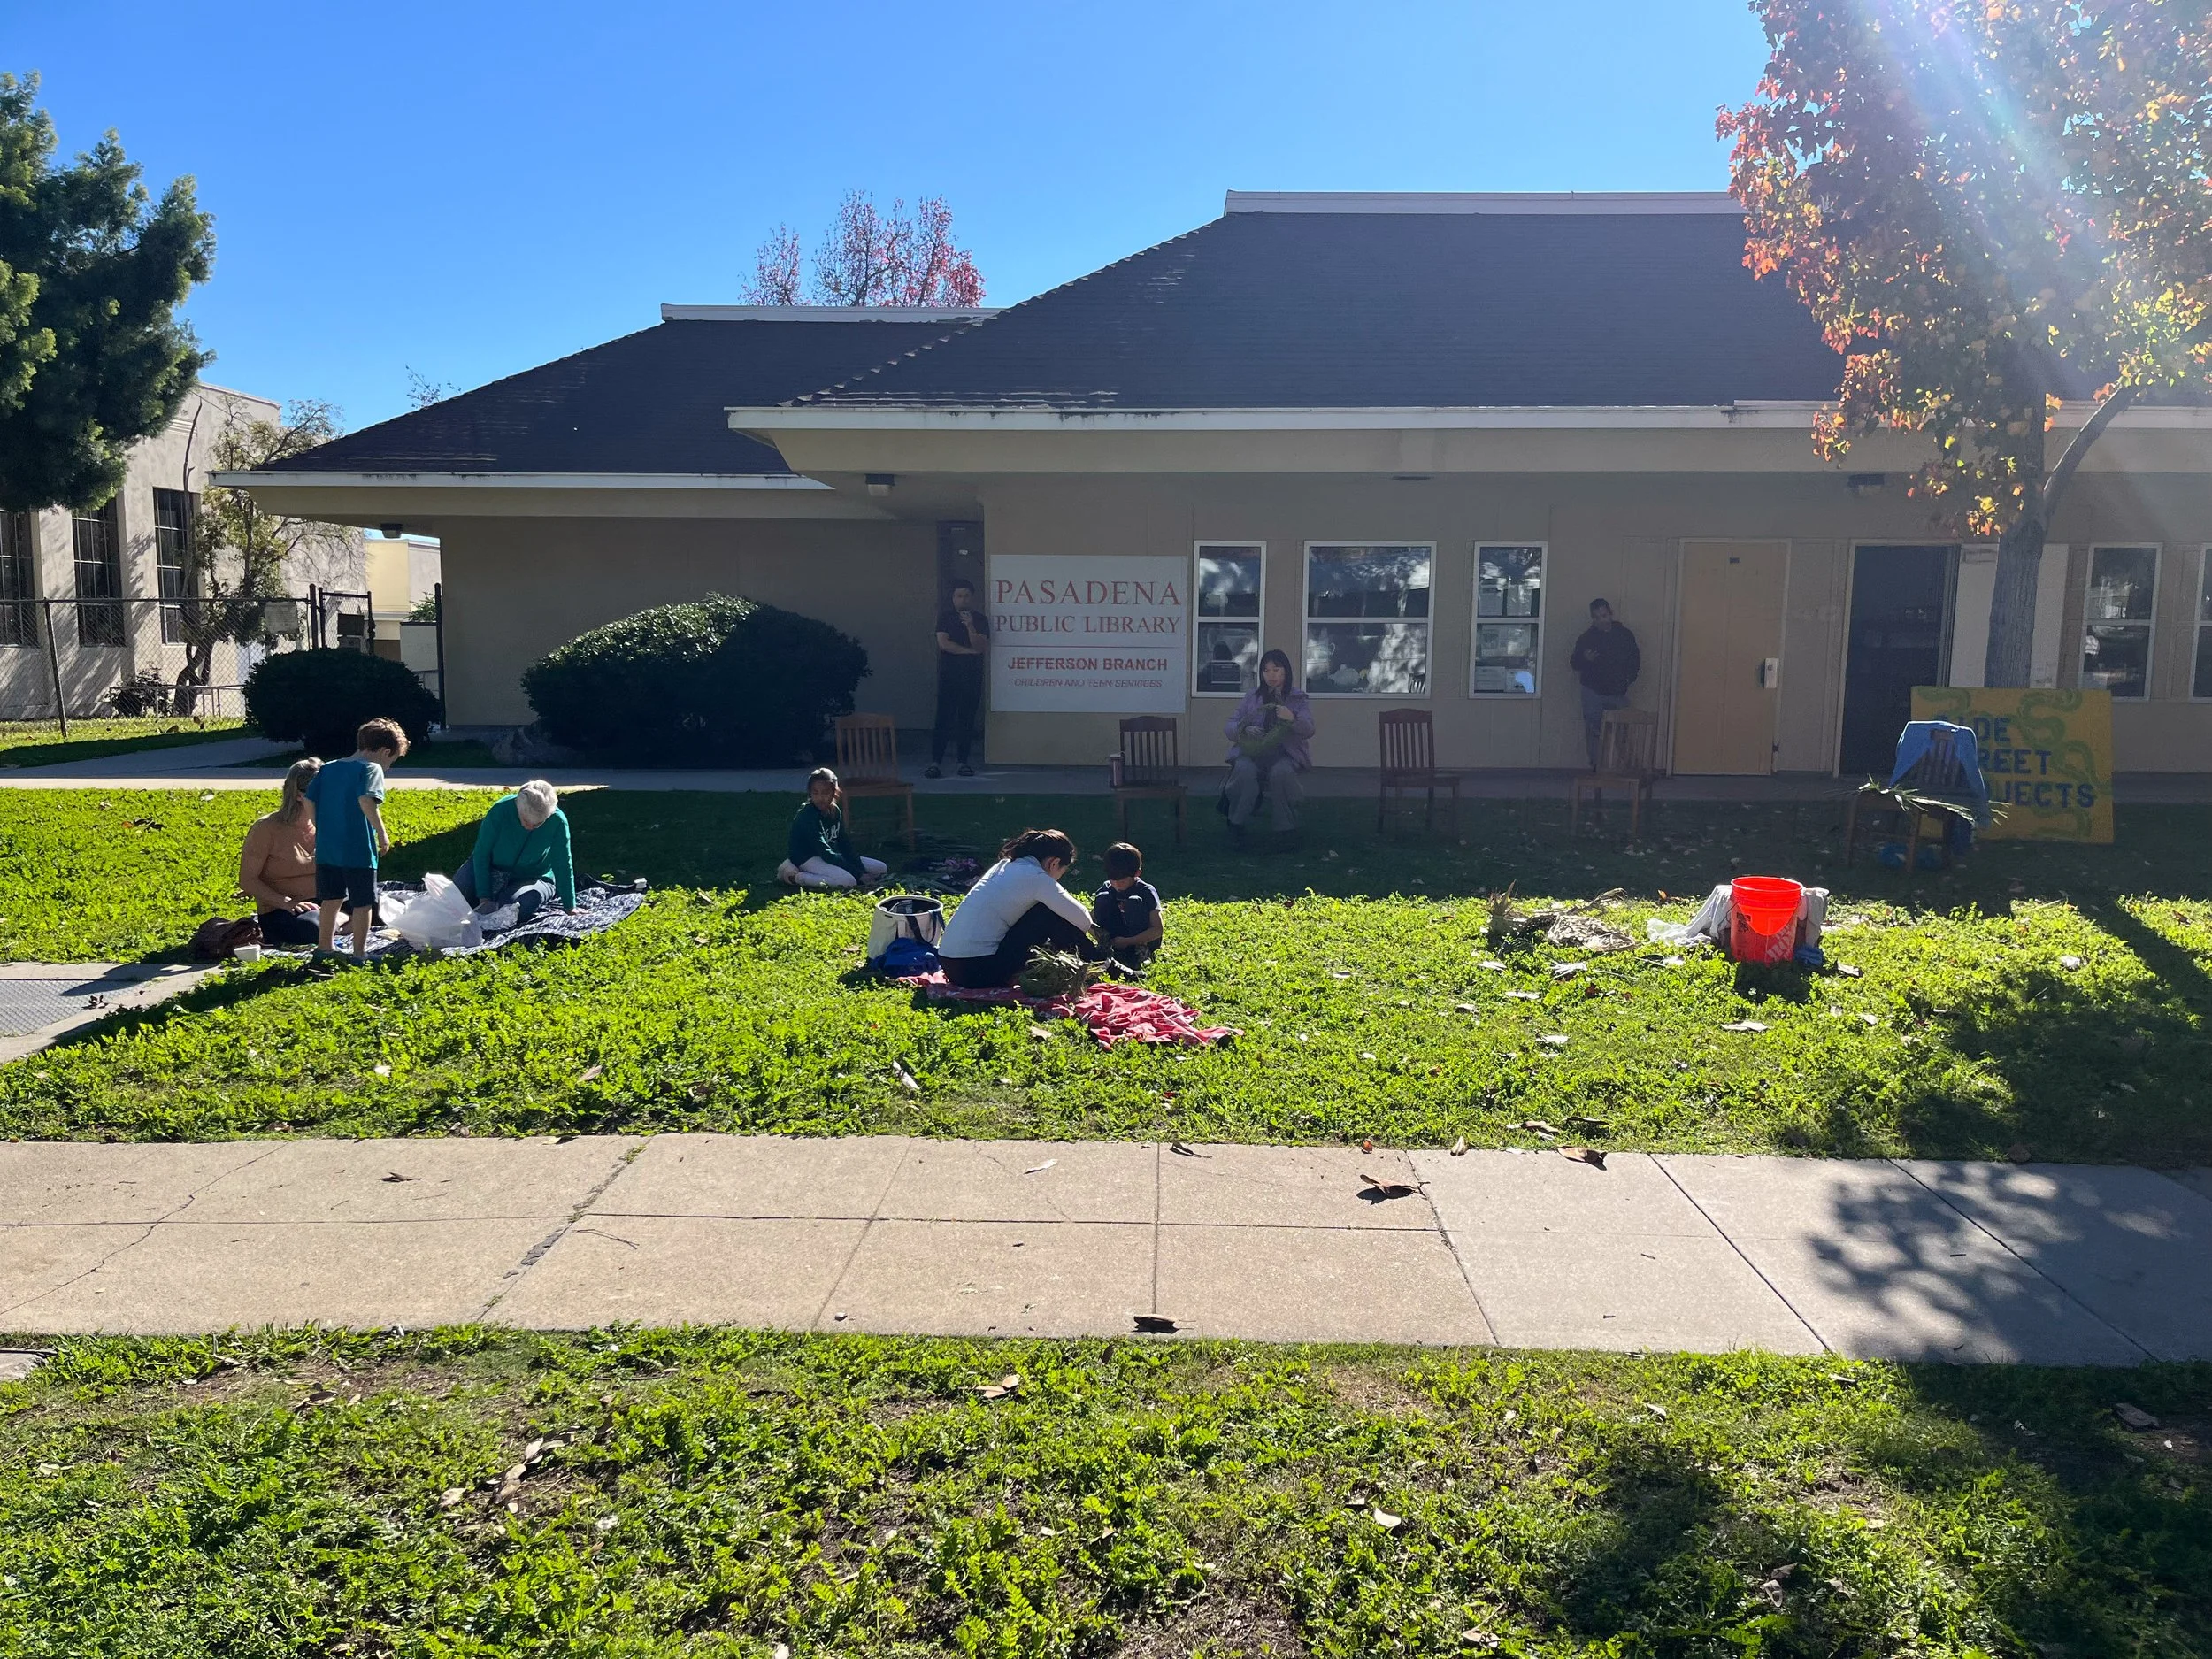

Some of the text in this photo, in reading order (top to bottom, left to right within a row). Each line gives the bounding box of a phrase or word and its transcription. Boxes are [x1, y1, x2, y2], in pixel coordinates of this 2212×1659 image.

[995, 580, 1181, 605] PASADENA
[996, 615, 1181, 633] PUBLIC LIBRARY
[1008, 657, 1168, 671] JEFFERSON BRANCH
[1014, 678, 1163, 688] CHILDREN AND TEEN SERVICES
[1978, 749, 2052, 775] REET
[1996, 781, 2094, 808] JECTS
